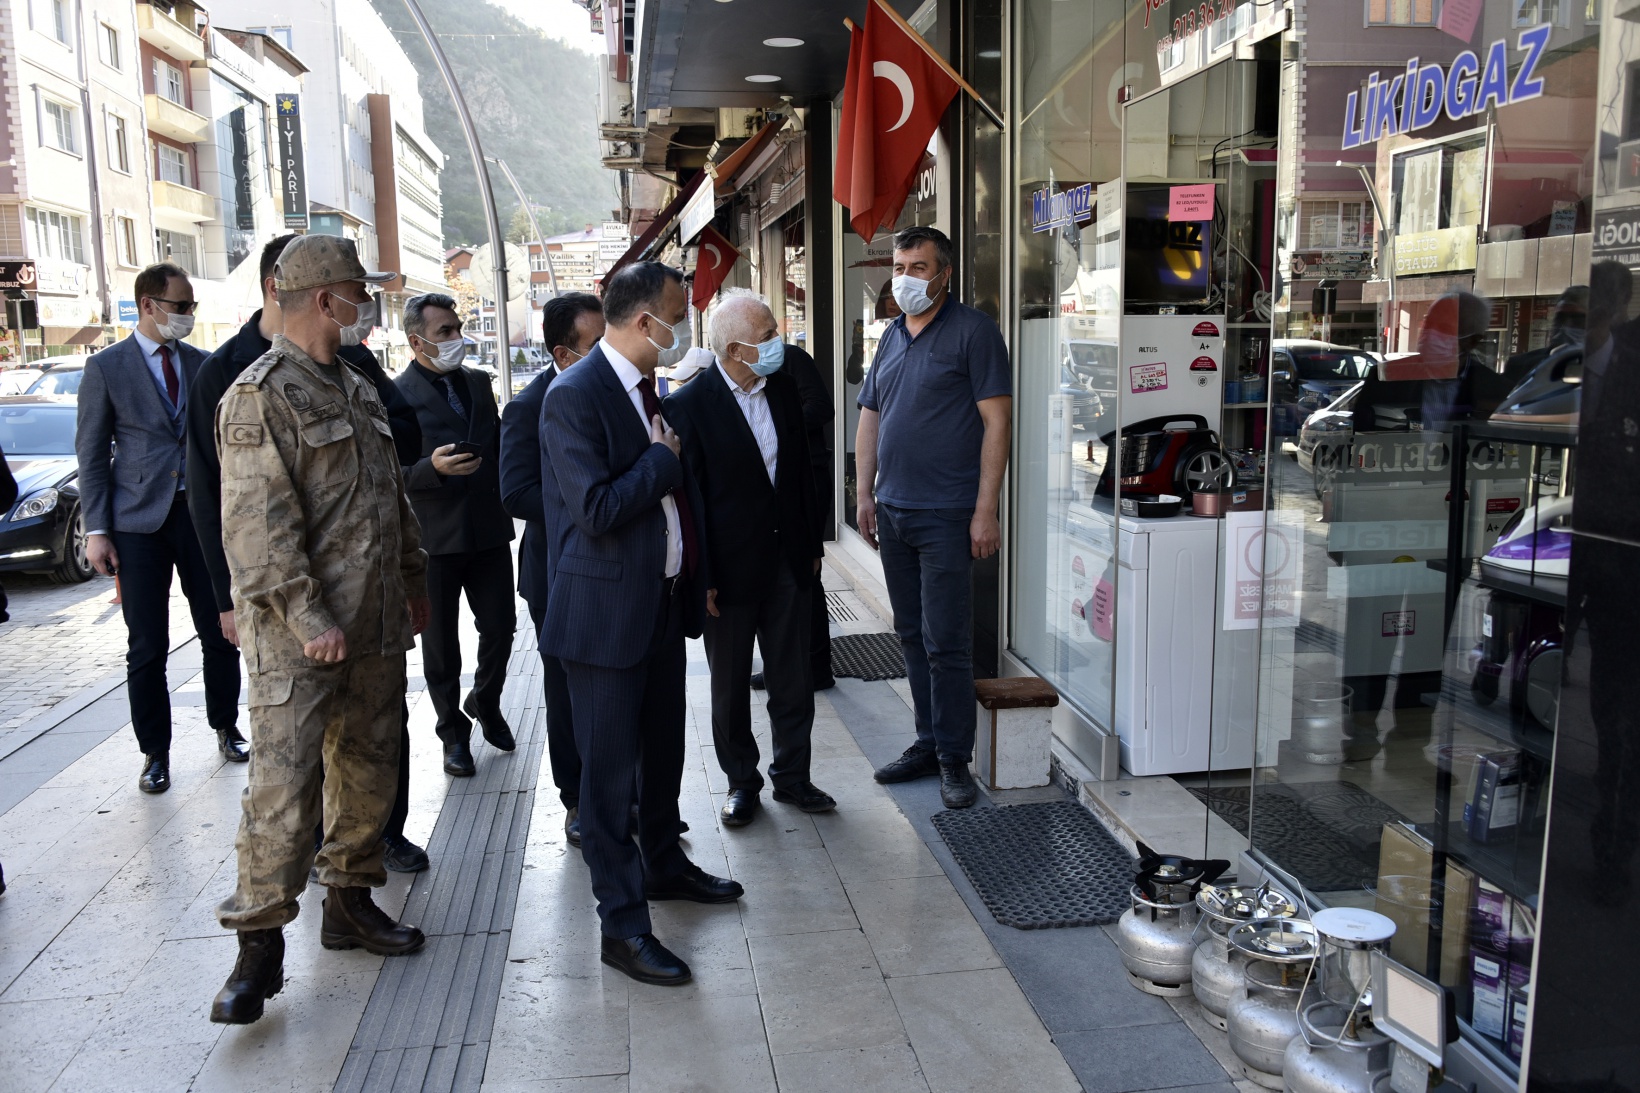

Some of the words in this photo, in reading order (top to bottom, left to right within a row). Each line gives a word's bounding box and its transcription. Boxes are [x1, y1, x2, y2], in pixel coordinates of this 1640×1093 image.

[1173, 9, 1196, 45] 213
[1198, 0, 1215, 32] 36
[1218, 0, 1236, 20] 20
[1341, 22, 1552, 150] LİKİDGAZ
[284, 117, 294, 156] İYİ
[287, 159, 298, 213] PARTİ
[917, 165, 937, 202] JOV
[1032, 183, 1092, 228] Milangaz
[120, 305, 138, 313] beko
[1199, 342, 1210, 350] A+
[1486, 523, 1499, 533] A+
